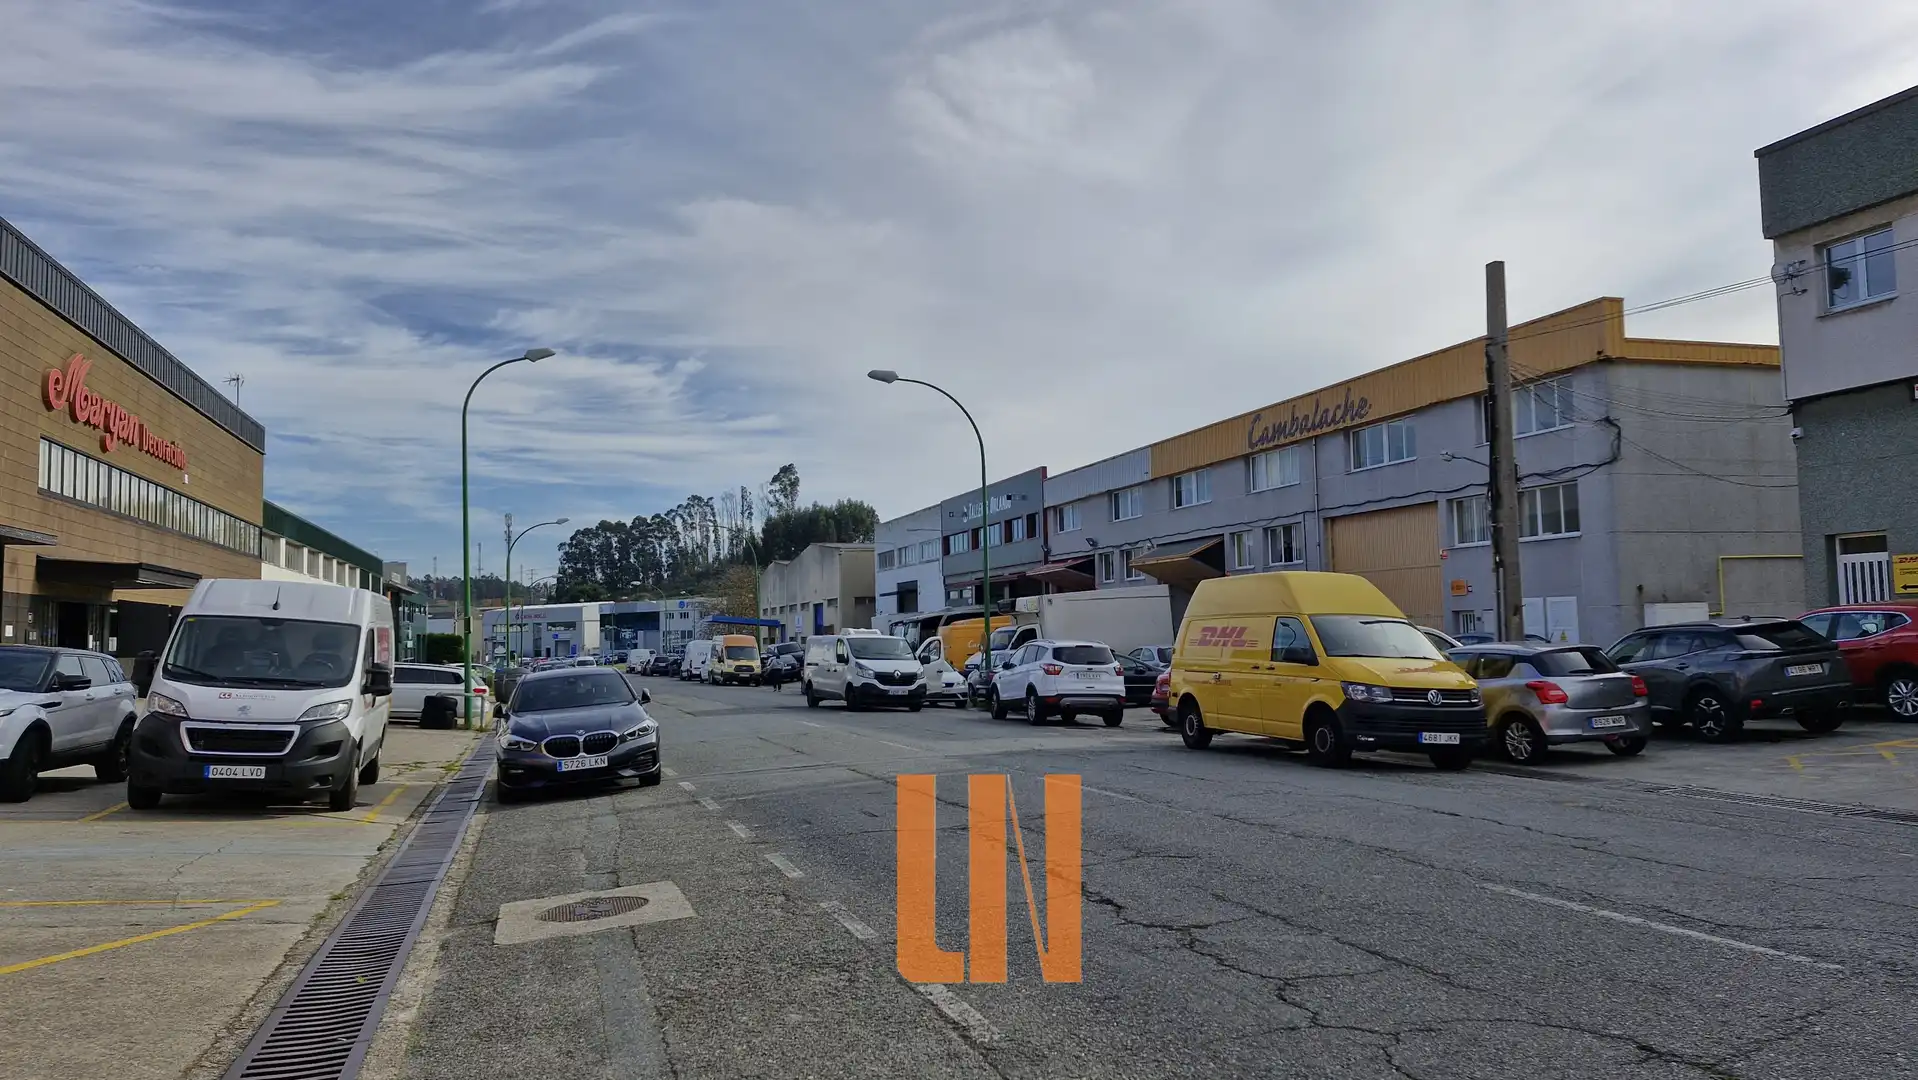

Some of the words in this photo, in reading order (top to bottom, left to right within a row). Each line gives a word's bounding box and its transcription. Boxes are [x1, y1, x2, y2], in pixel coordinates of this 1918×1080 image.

[43, 352, 140, 453] Maryan
[1247, 387, 1372, 450] Cambalache
[1197, 626, 1249, 648] DHL
[211, 767, 238, 777] 0404
[241, 767, 263, 777] LVD
[563, 759, 587, 770] 5726
[588, 757, 606, 767] LKN
